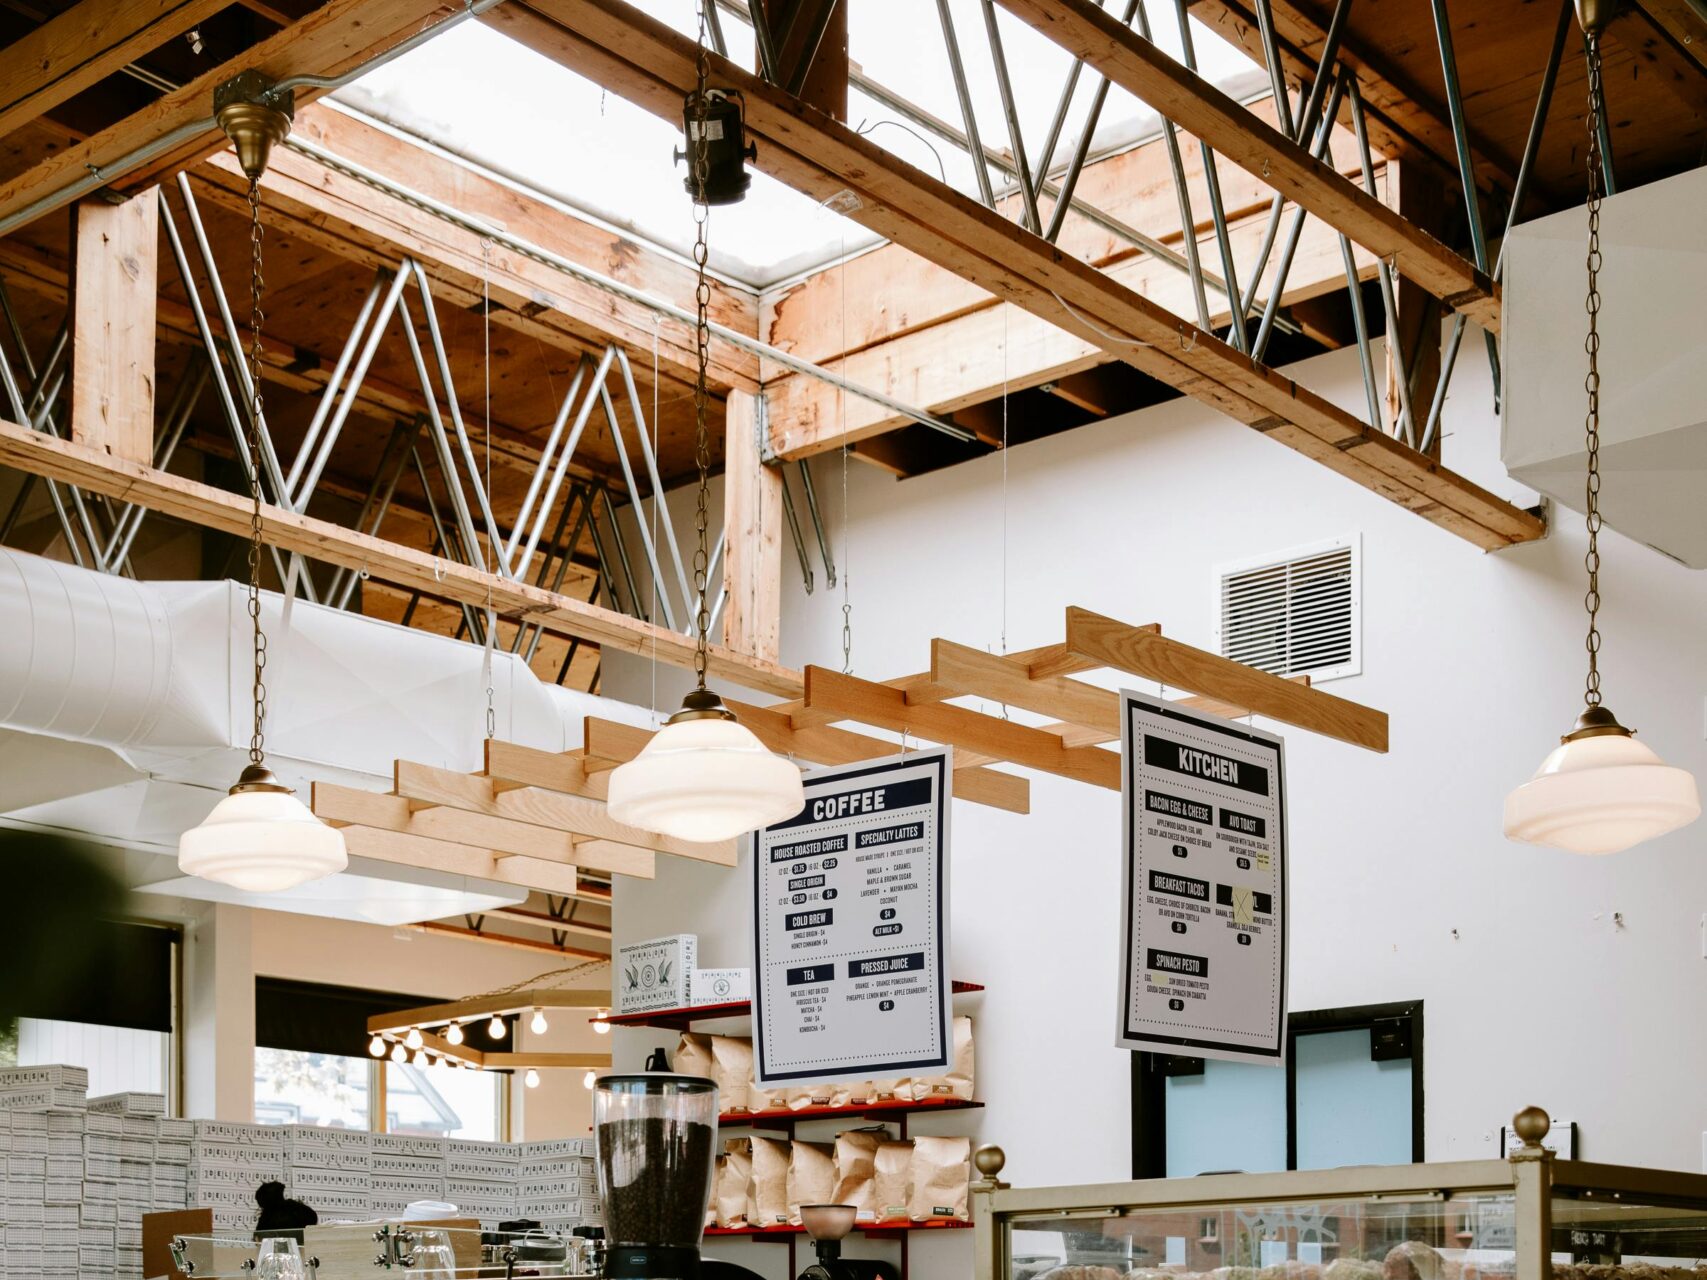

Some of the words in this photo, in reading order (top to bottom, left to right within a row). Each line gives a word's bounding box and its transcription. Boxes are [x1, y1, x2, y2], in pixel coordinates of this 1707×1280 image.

[1178, 747, 1239, 784] KITCHEN
[813, 789, 885, 821] COFFEE
[1150, 795, 1169, 811] BACON
[1170, 800, 1181, 814] EGG
[1182, 803, 1187, 815] &
[1188, 804, 1208, 820] CHEESE
[1229, 814, 1239, 828] AVO
[1240, 818, 1256, 832] TOAST
[861, 830, 894, 845] SPECIALTY
[895, 826, 918, 840] LATTES
[1168, 832, 1179, 841] CHEESE
[774, 847, 794, 860] HOUSE
[794, 842, 821, 856] ROASTED
[822, 838, 844, 851] COFFEE
[867, 867, 882, 875] VANILLA
[894, 862, 911, 871] CARAMEL
[790, 879, 806, 889] SINGLE
[884, 875, 898, 883] BROWN
[1155, 875, 1186, 893] BREAKFAST
[1187, 881, 1204, 897] TACOS
[827, 890, 832, 898] $4
[860, 888, 879, 897] LAVENDER
[793, 916, 808, 927] COLD
[809, 913, 826, 925] BREW
[632, 950, 664, 960] PARLOR
[861, 960, 888, 974] PRESSED
[890, 958, 908, 970] JUICE
[1156, 954, 1181, 969] SPINACH
[1182, 959, 1200, 972] PESTO
[804, 970, 815, 981] TEA
[891, 977, 917, 985] POMEGRANATE
[625, 991, 673, 1003] DOUGHNUTS
[866, 992, 878, 1000] LEMON
[906, 987, 928, 995] CRANBERRY
[800, 1025, 818, 1033] KOMBUCHA
[212, 1127, 276, 1138] DELICIOUS
[303, 1130, 364, 1141] DELICIOUS
[378, 1139, 436, 1148] DELICIOUS
[530, 1143, 566, 1152] PARLOR
[208, 1149, 275, 1158] DELICIOUS
[453, 1144, 512, 1154] DOUGHNUTS
[303, 1152, 364, 1162] DELICIOUS
[378, 1160, 436, 1170] DOUGHNUTS
[455, 1164, 511, 1174] DOUGHNUTS
[526, 1163, 563, 1172] PARLOR
[209, 1170, 275, 1180] DELICIOUS
[302, 1175, 363, 1184] DOUGHNUTS
[376, 1181, 435, 1190] DOUGHNUTS
[453, 1184, 509, 1192] DOUGHNUTS
[527, 1184, 564, 1192] PARLOR
[208, 1192, 254, 1200] DELICI
[302, 1196, 363, 1204] DOUGHNUTS
[460, 1204, 509, 1213] OUGHNUTS
[528, 1204, 565, 1212] PARLOR
